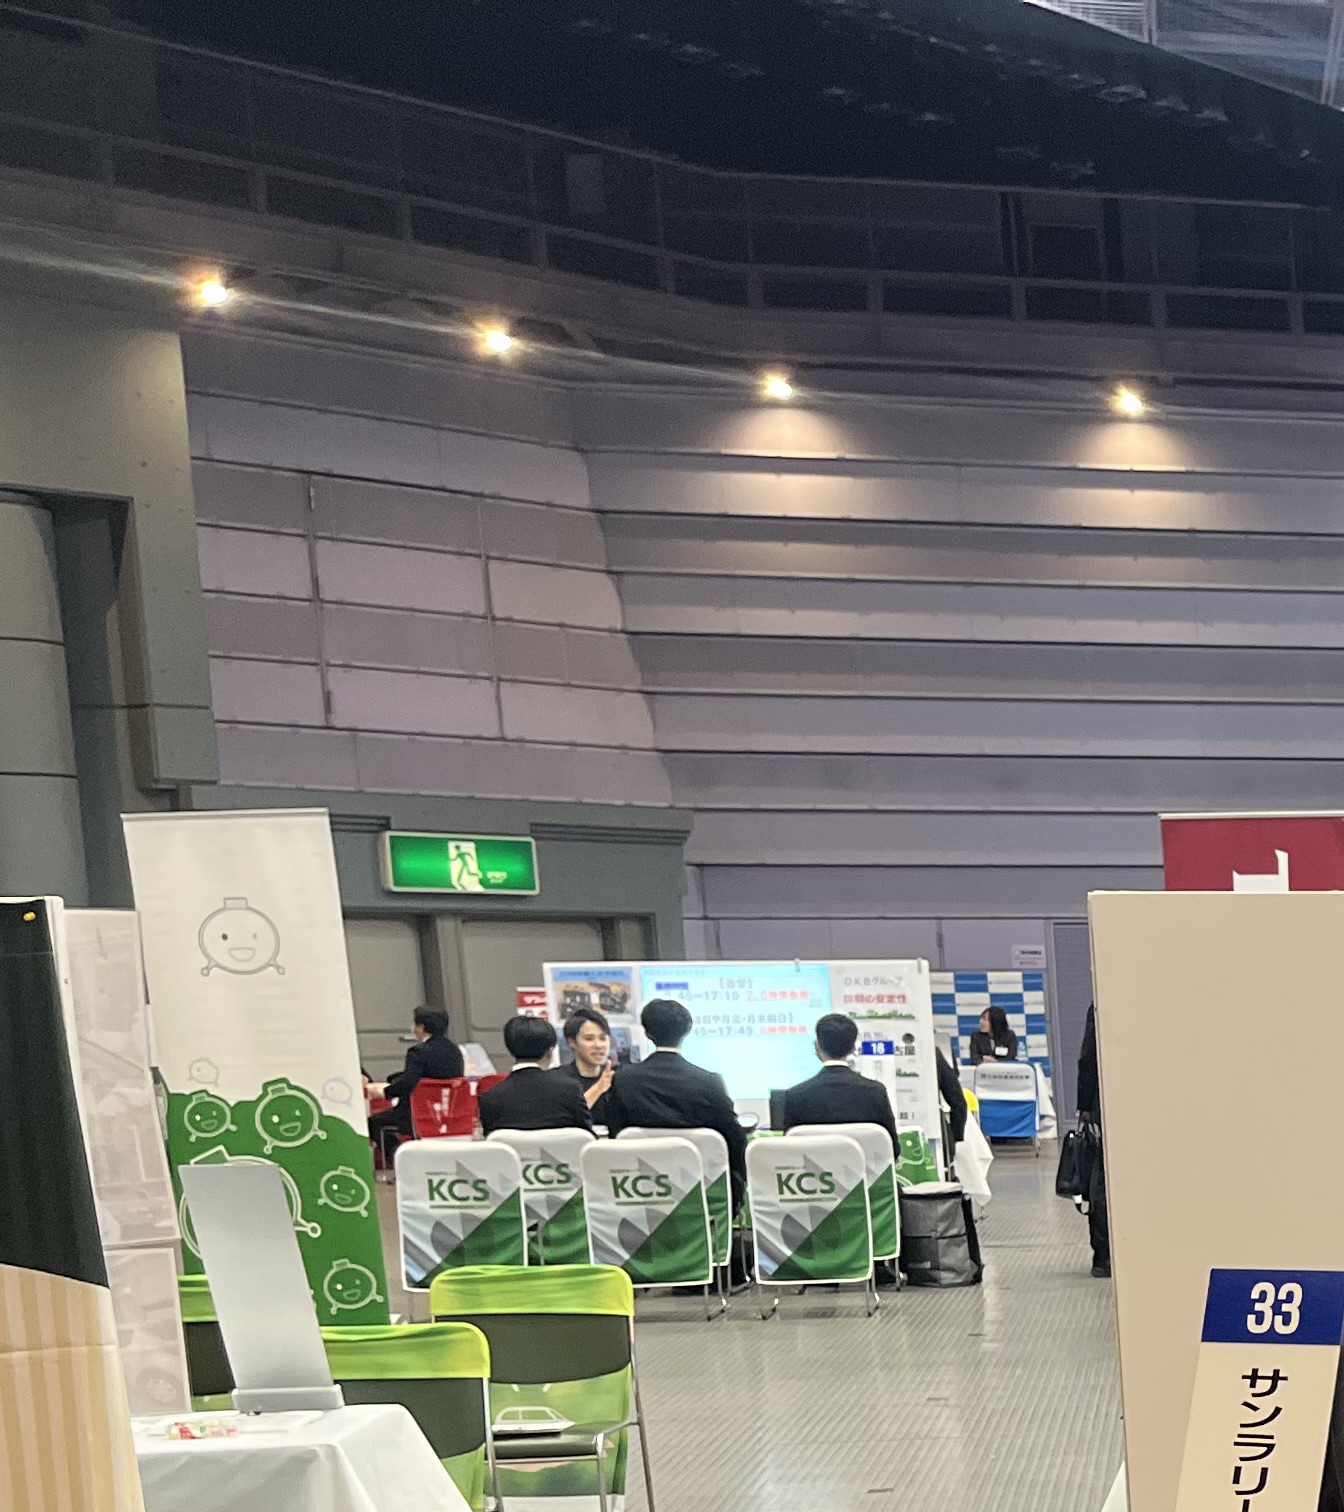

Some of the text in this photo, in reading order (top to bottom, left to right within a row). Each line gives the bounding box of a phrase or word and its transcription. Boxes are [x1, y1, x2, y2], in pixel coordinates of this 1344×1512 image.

[871, 1042, 885, 1055] 16
[427, 1178, 490, 1201] KCS
[611, 1174, 672, 1198] KCS
[776, 1171, 836, 1196] KCS
[1246, 1281, 1304, 1335] 33
